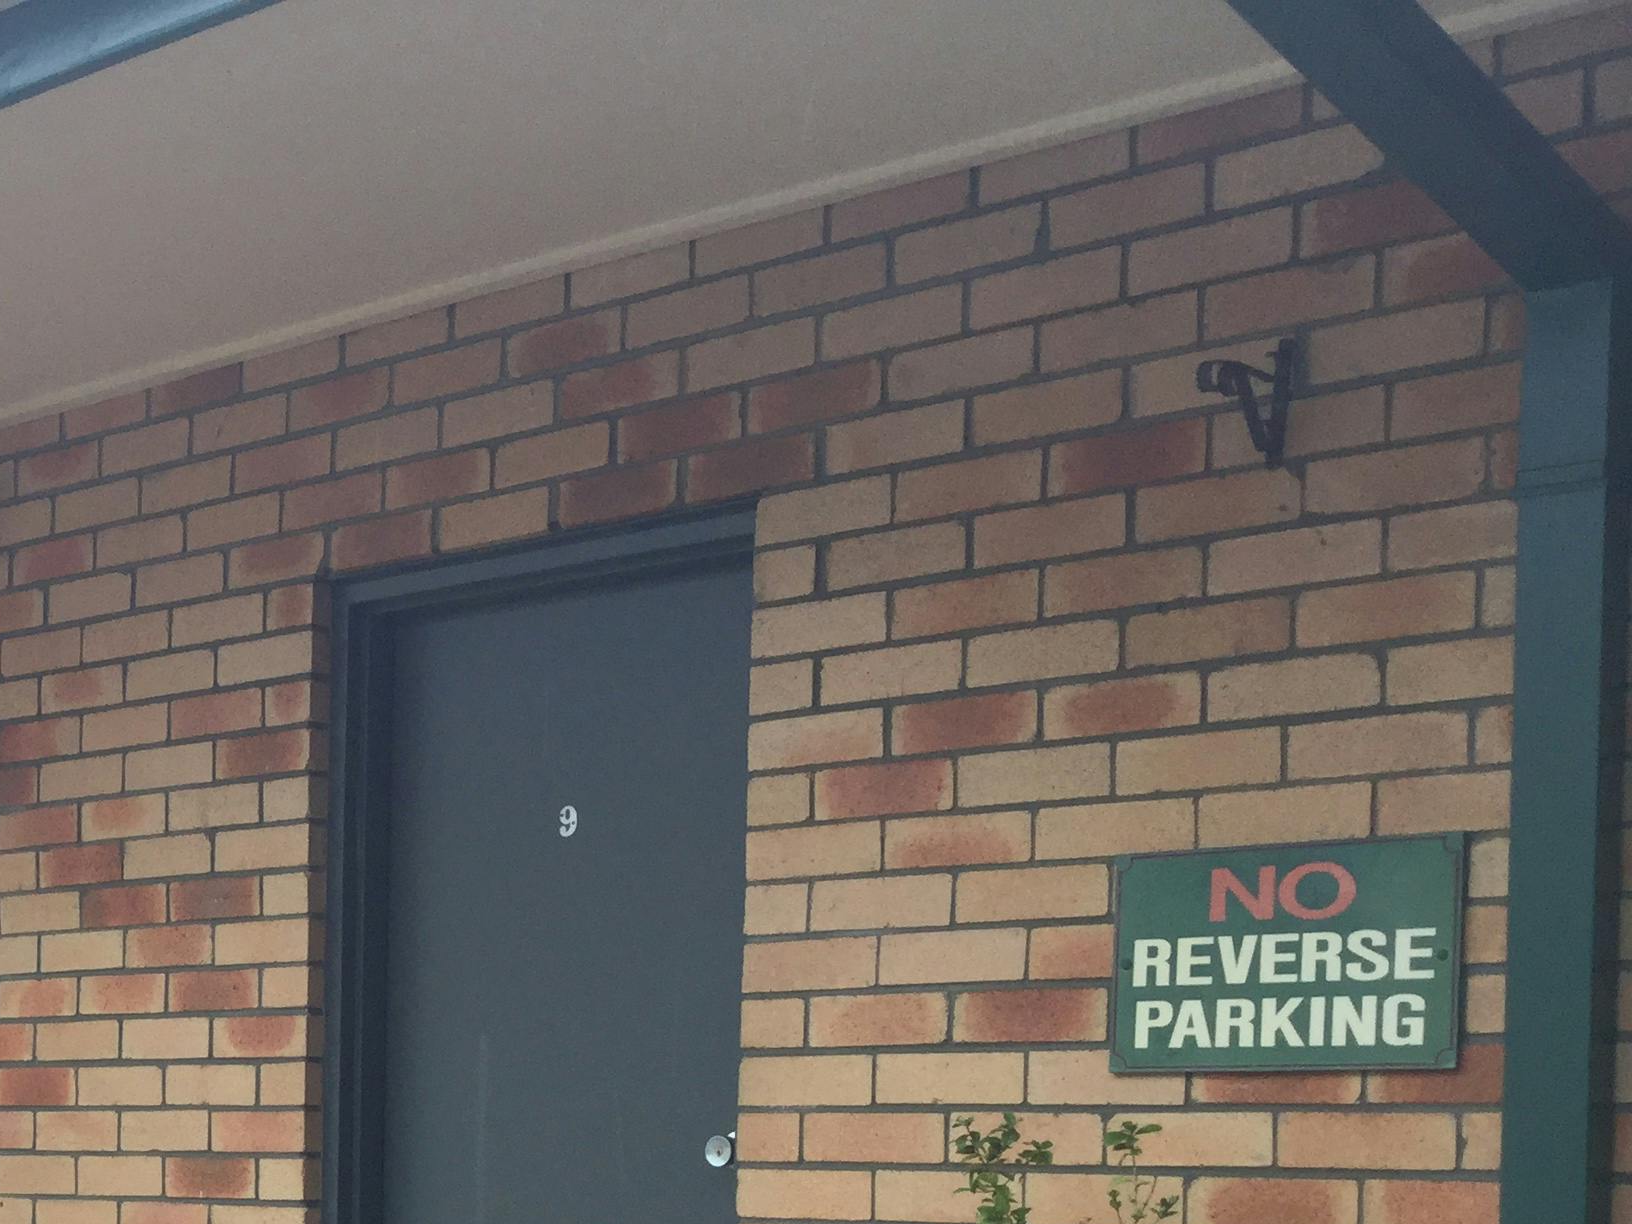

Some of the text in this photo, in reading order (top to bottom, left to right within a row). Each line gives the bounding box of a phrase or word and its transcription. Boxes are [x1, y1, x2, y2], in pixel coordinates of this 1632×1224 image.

[559, 805, 578, 837] 9
[1209, 861, 1357, 923] NO
[1132, 927, 1437, 988] REVERSE
[1134, 993, 1427, 1049] PARKING
